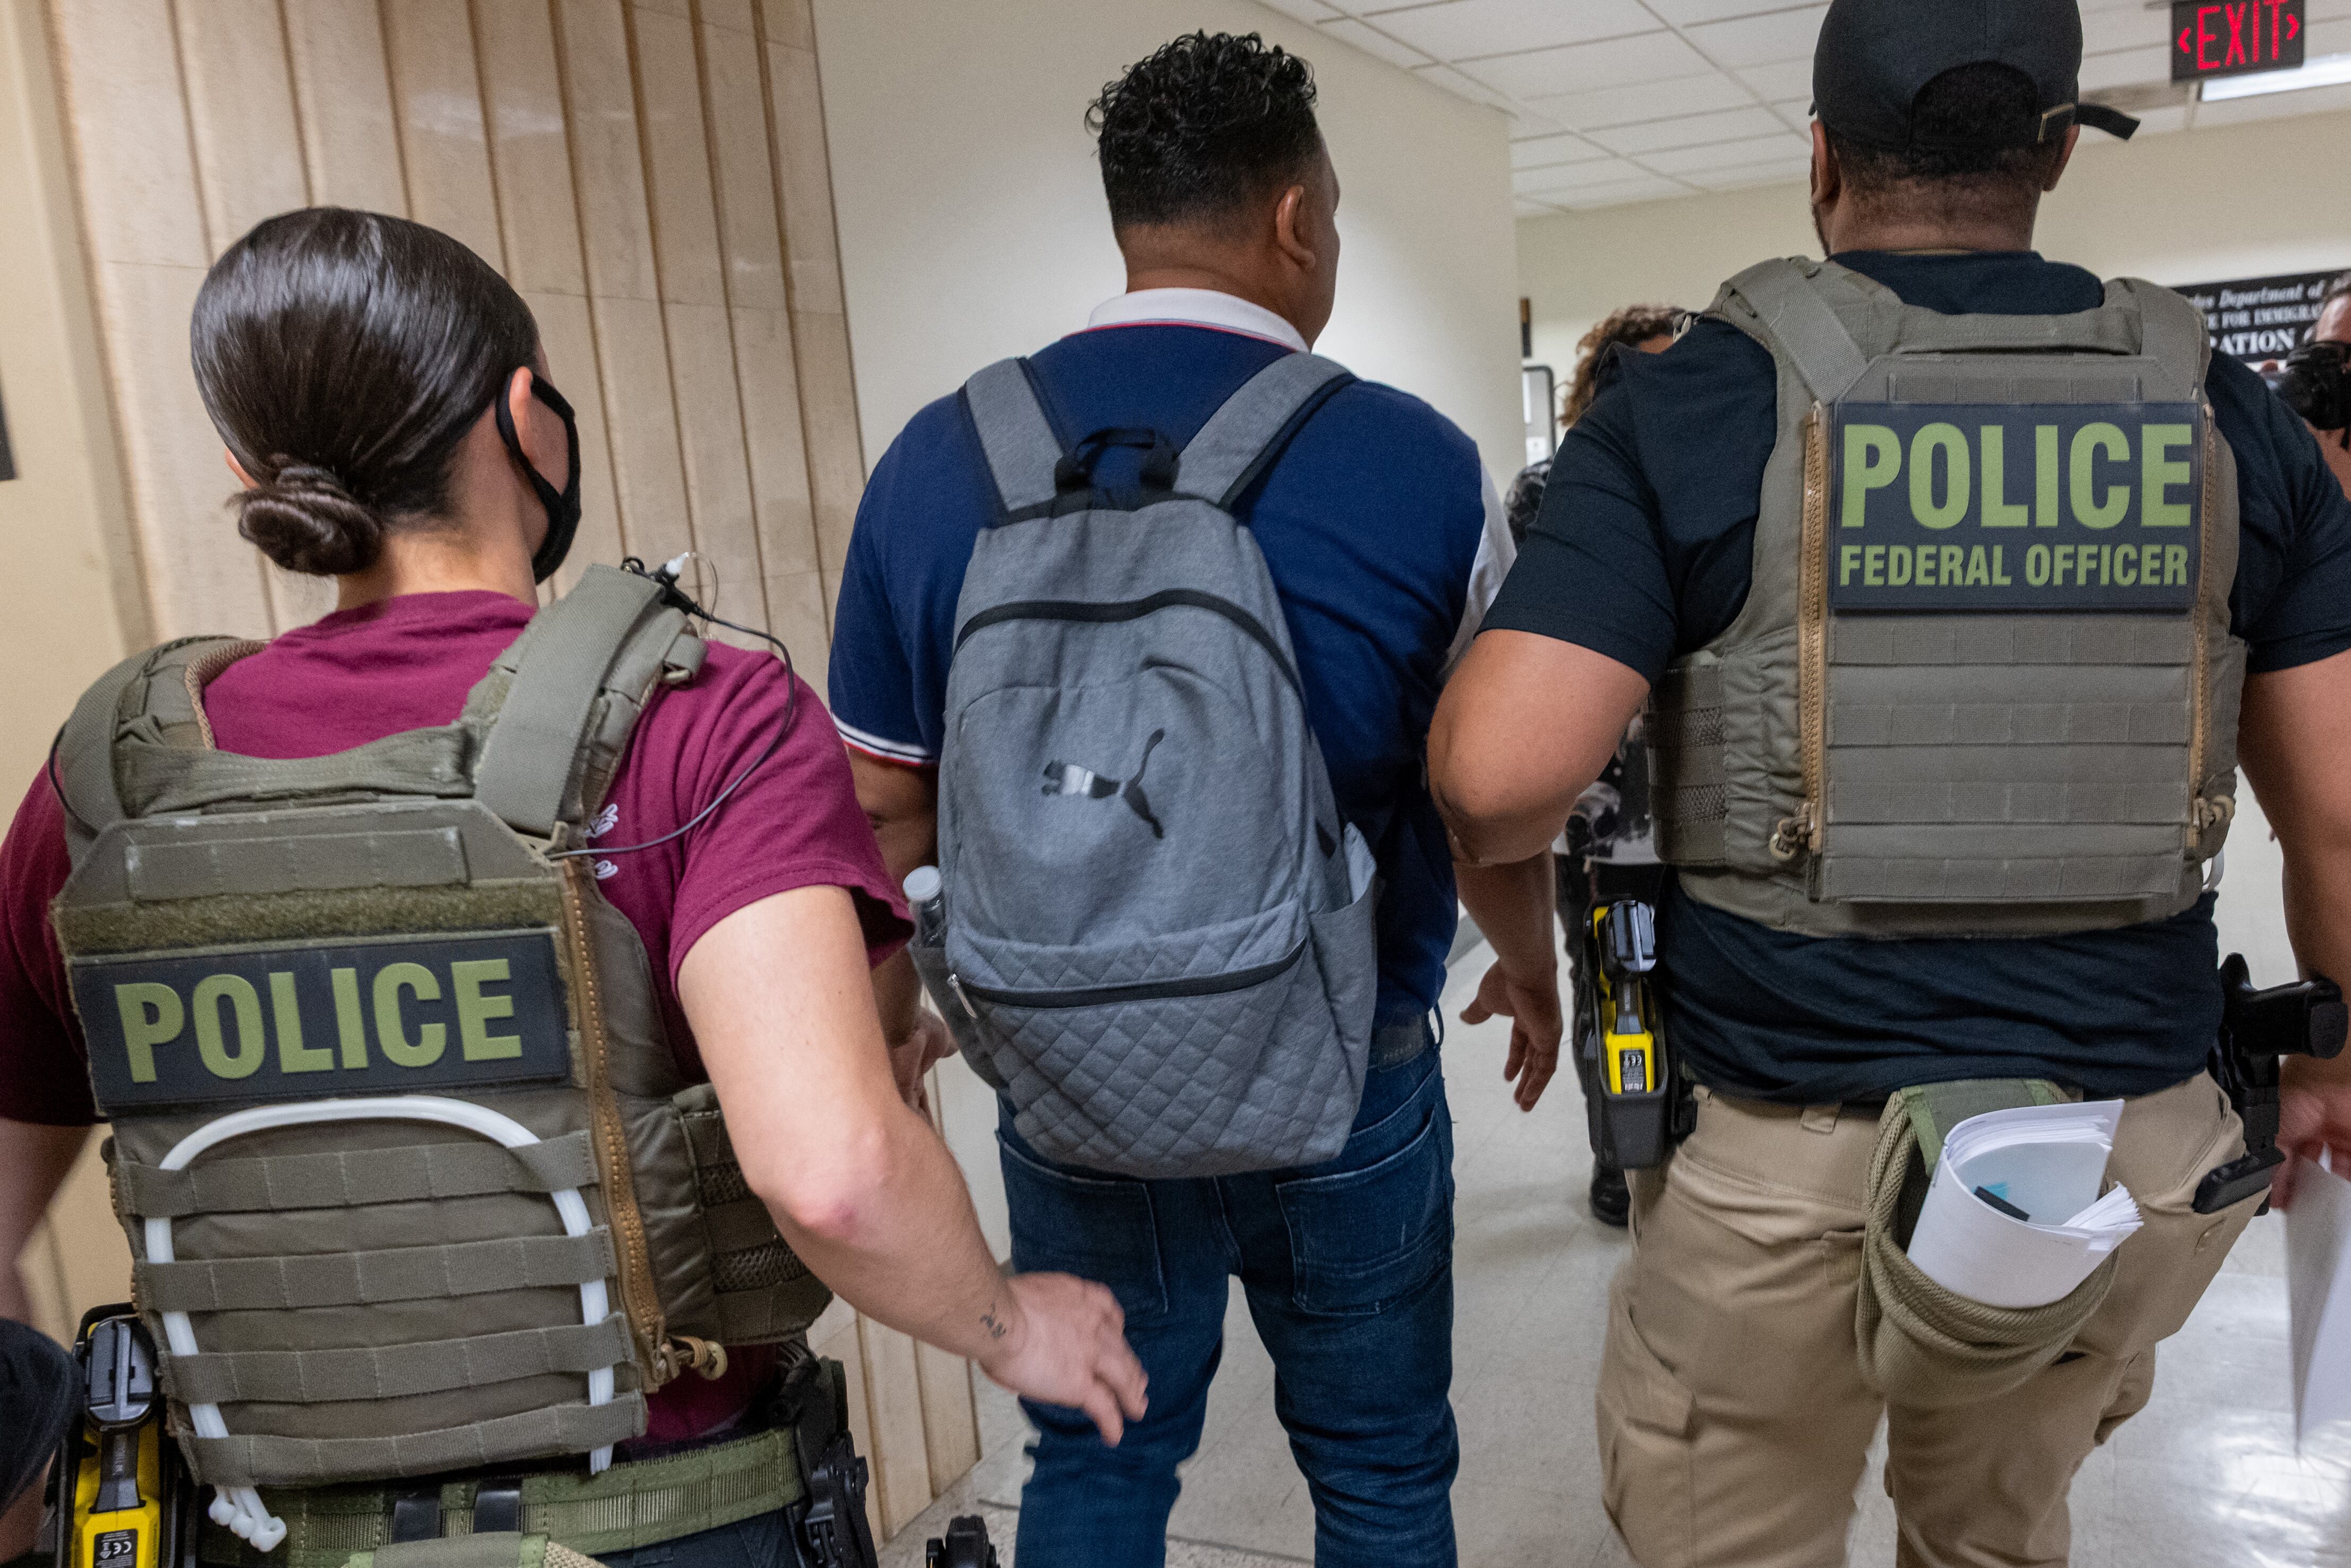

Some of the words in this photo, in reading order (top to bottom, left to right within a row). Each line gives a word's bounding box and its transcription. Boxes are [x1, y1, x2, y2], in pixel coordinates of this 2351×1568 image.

[2197, 0, 2289, 70] EXIT
[2219, 282, 2304, 309] Department
[1841, 422, 2193, 529] POLICE
[1840, 545, 2012, 586] FEDERAL
[2026, 544, 2189, 586] OFFICER
[115, 958, 522, 1083] POLICE
